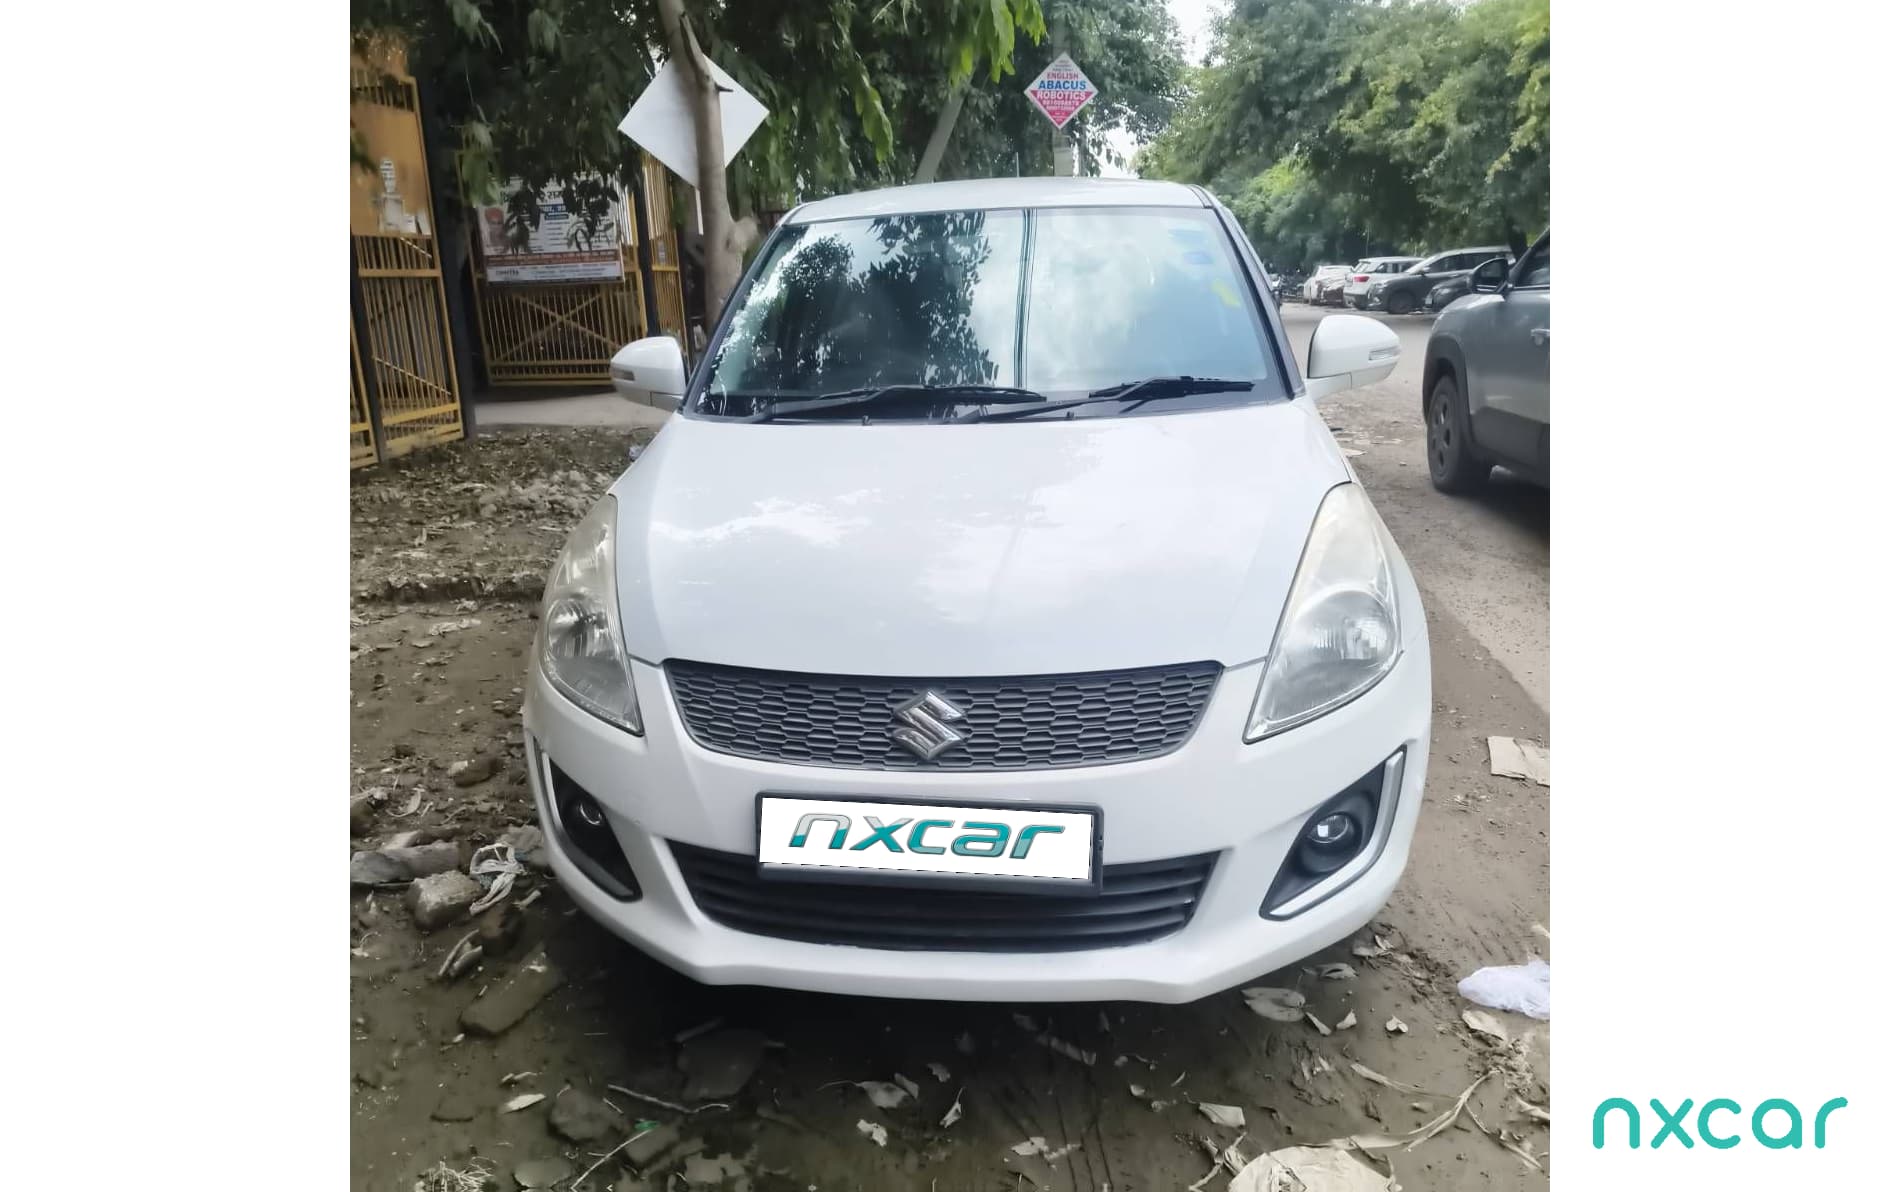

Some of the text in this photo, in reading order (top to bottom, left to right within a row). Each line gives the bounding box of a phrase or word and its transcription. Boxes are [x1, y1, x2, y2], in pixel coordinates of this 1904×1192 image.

[1046, 72, 1079, 80] ENGLISH
[1038, 80, 1087, 90] ABACUS
[1036, 91, 1086, 101] ROBOTICS
